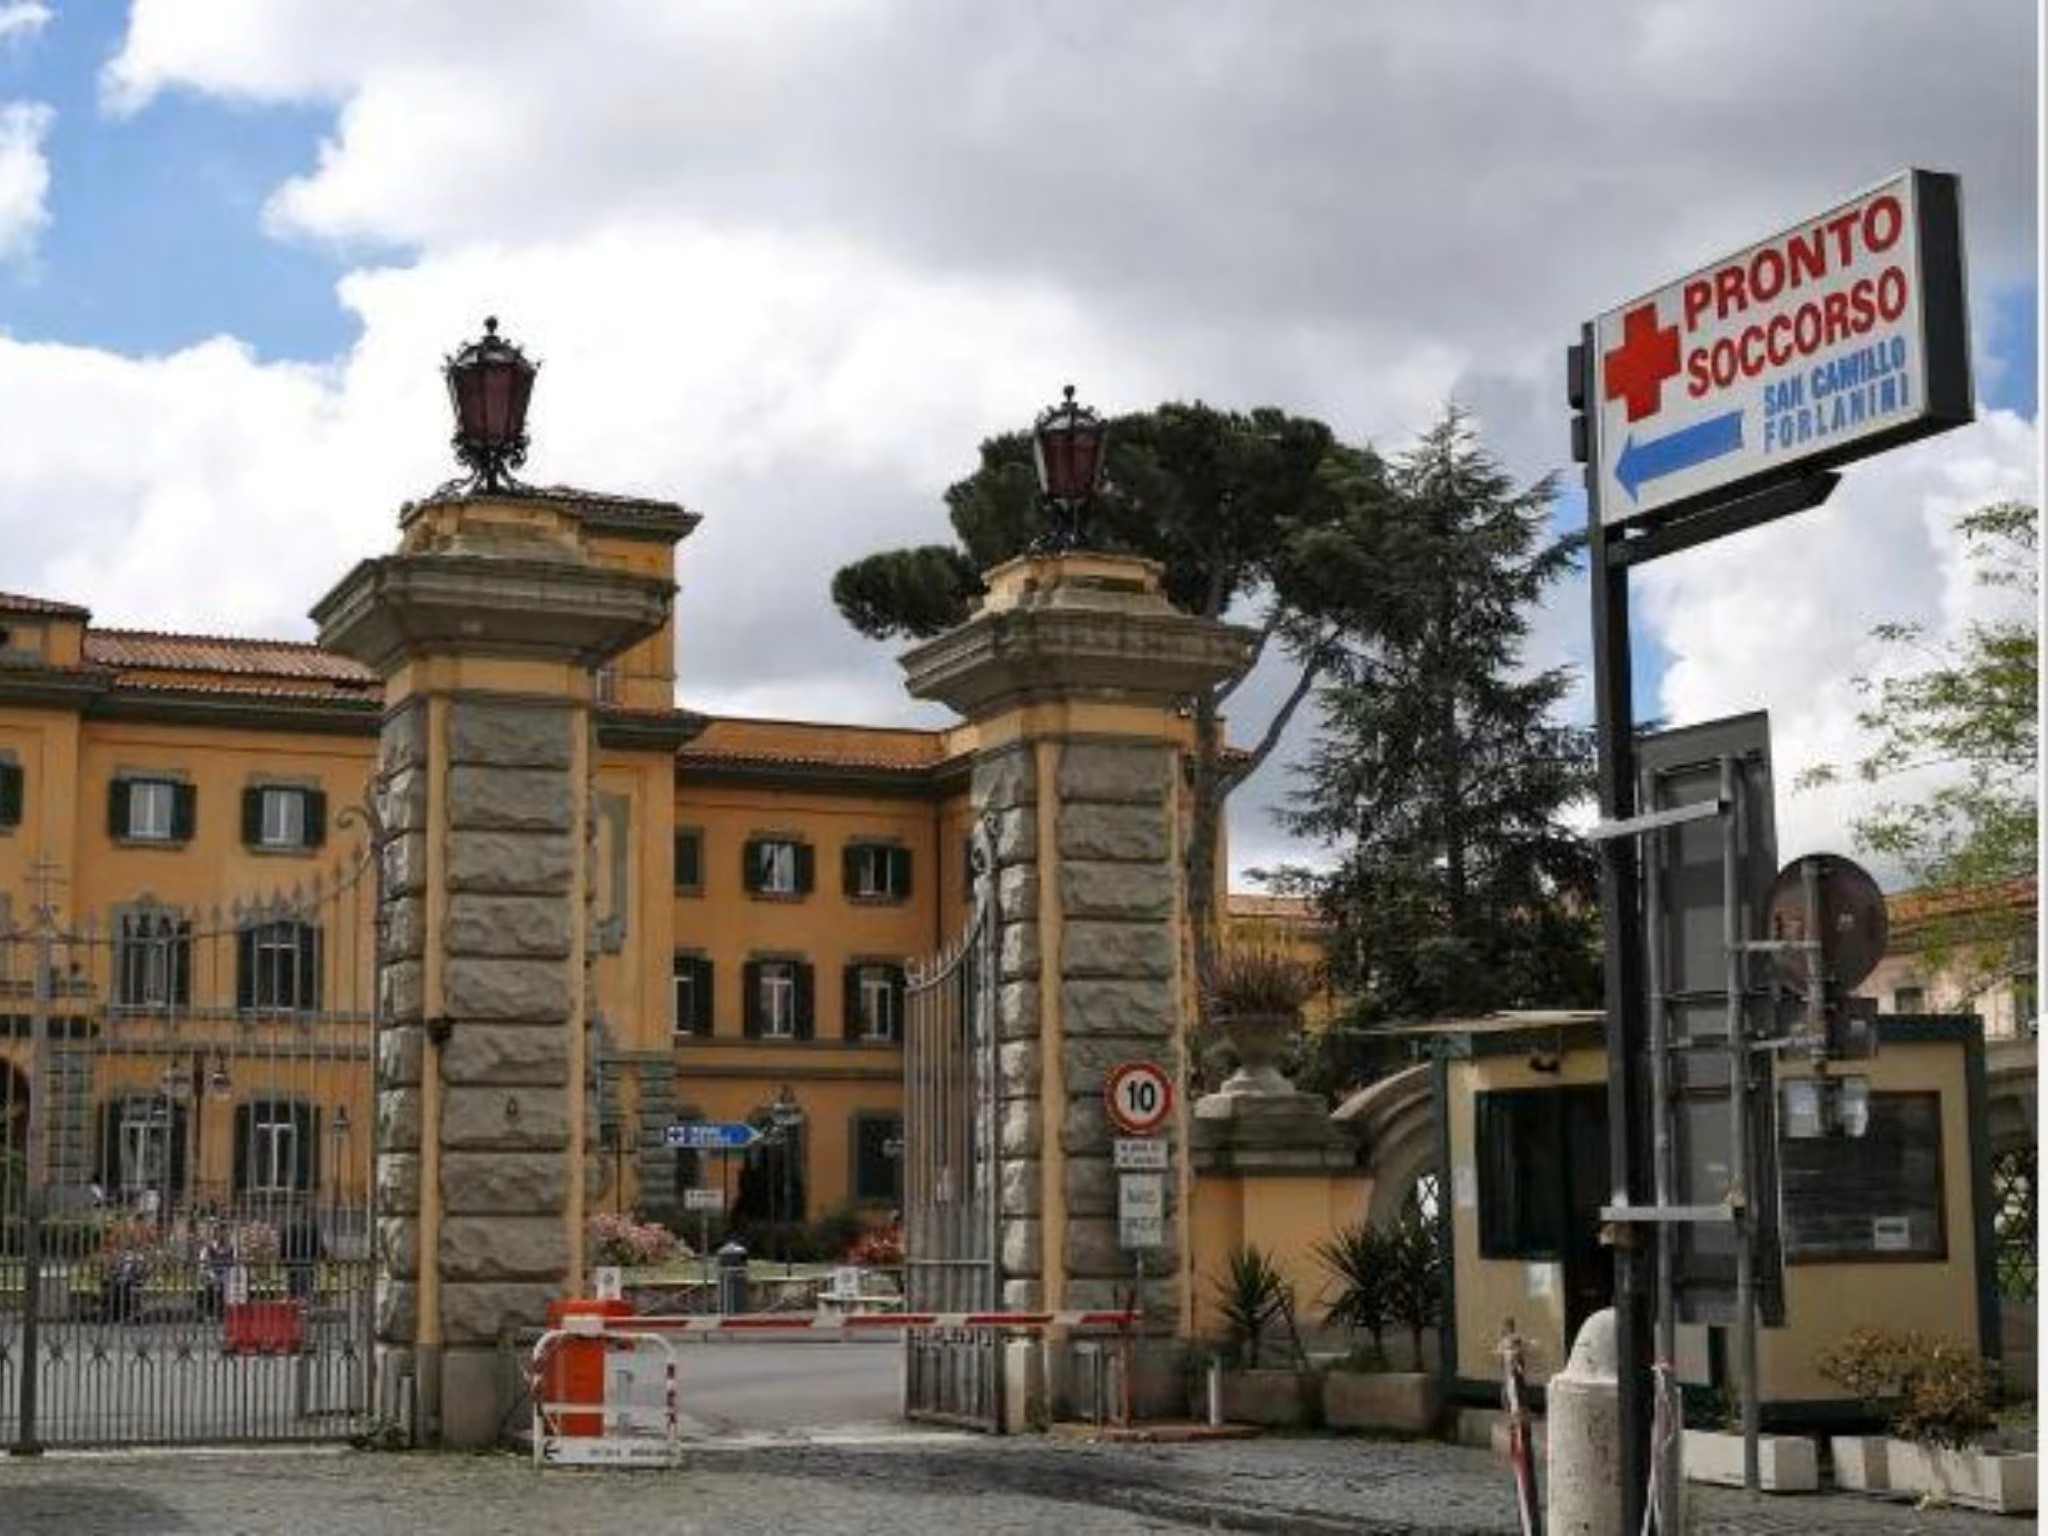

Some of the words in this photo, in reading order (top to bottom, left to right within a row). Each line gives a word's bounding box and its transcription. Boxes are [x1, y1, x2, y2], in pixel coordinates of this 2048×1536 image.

[1683, 195, 1902, 332] PRONTO
[1687, 265, 1907, 398] SOCCORSO
[1763, 372, 1804, 418] SAN
[1811, 335, 1906, 399] CAMILLO
[1763, 372, 1909, 454] FORLANINI
[1127, 1081, 1155, 1112] 10
